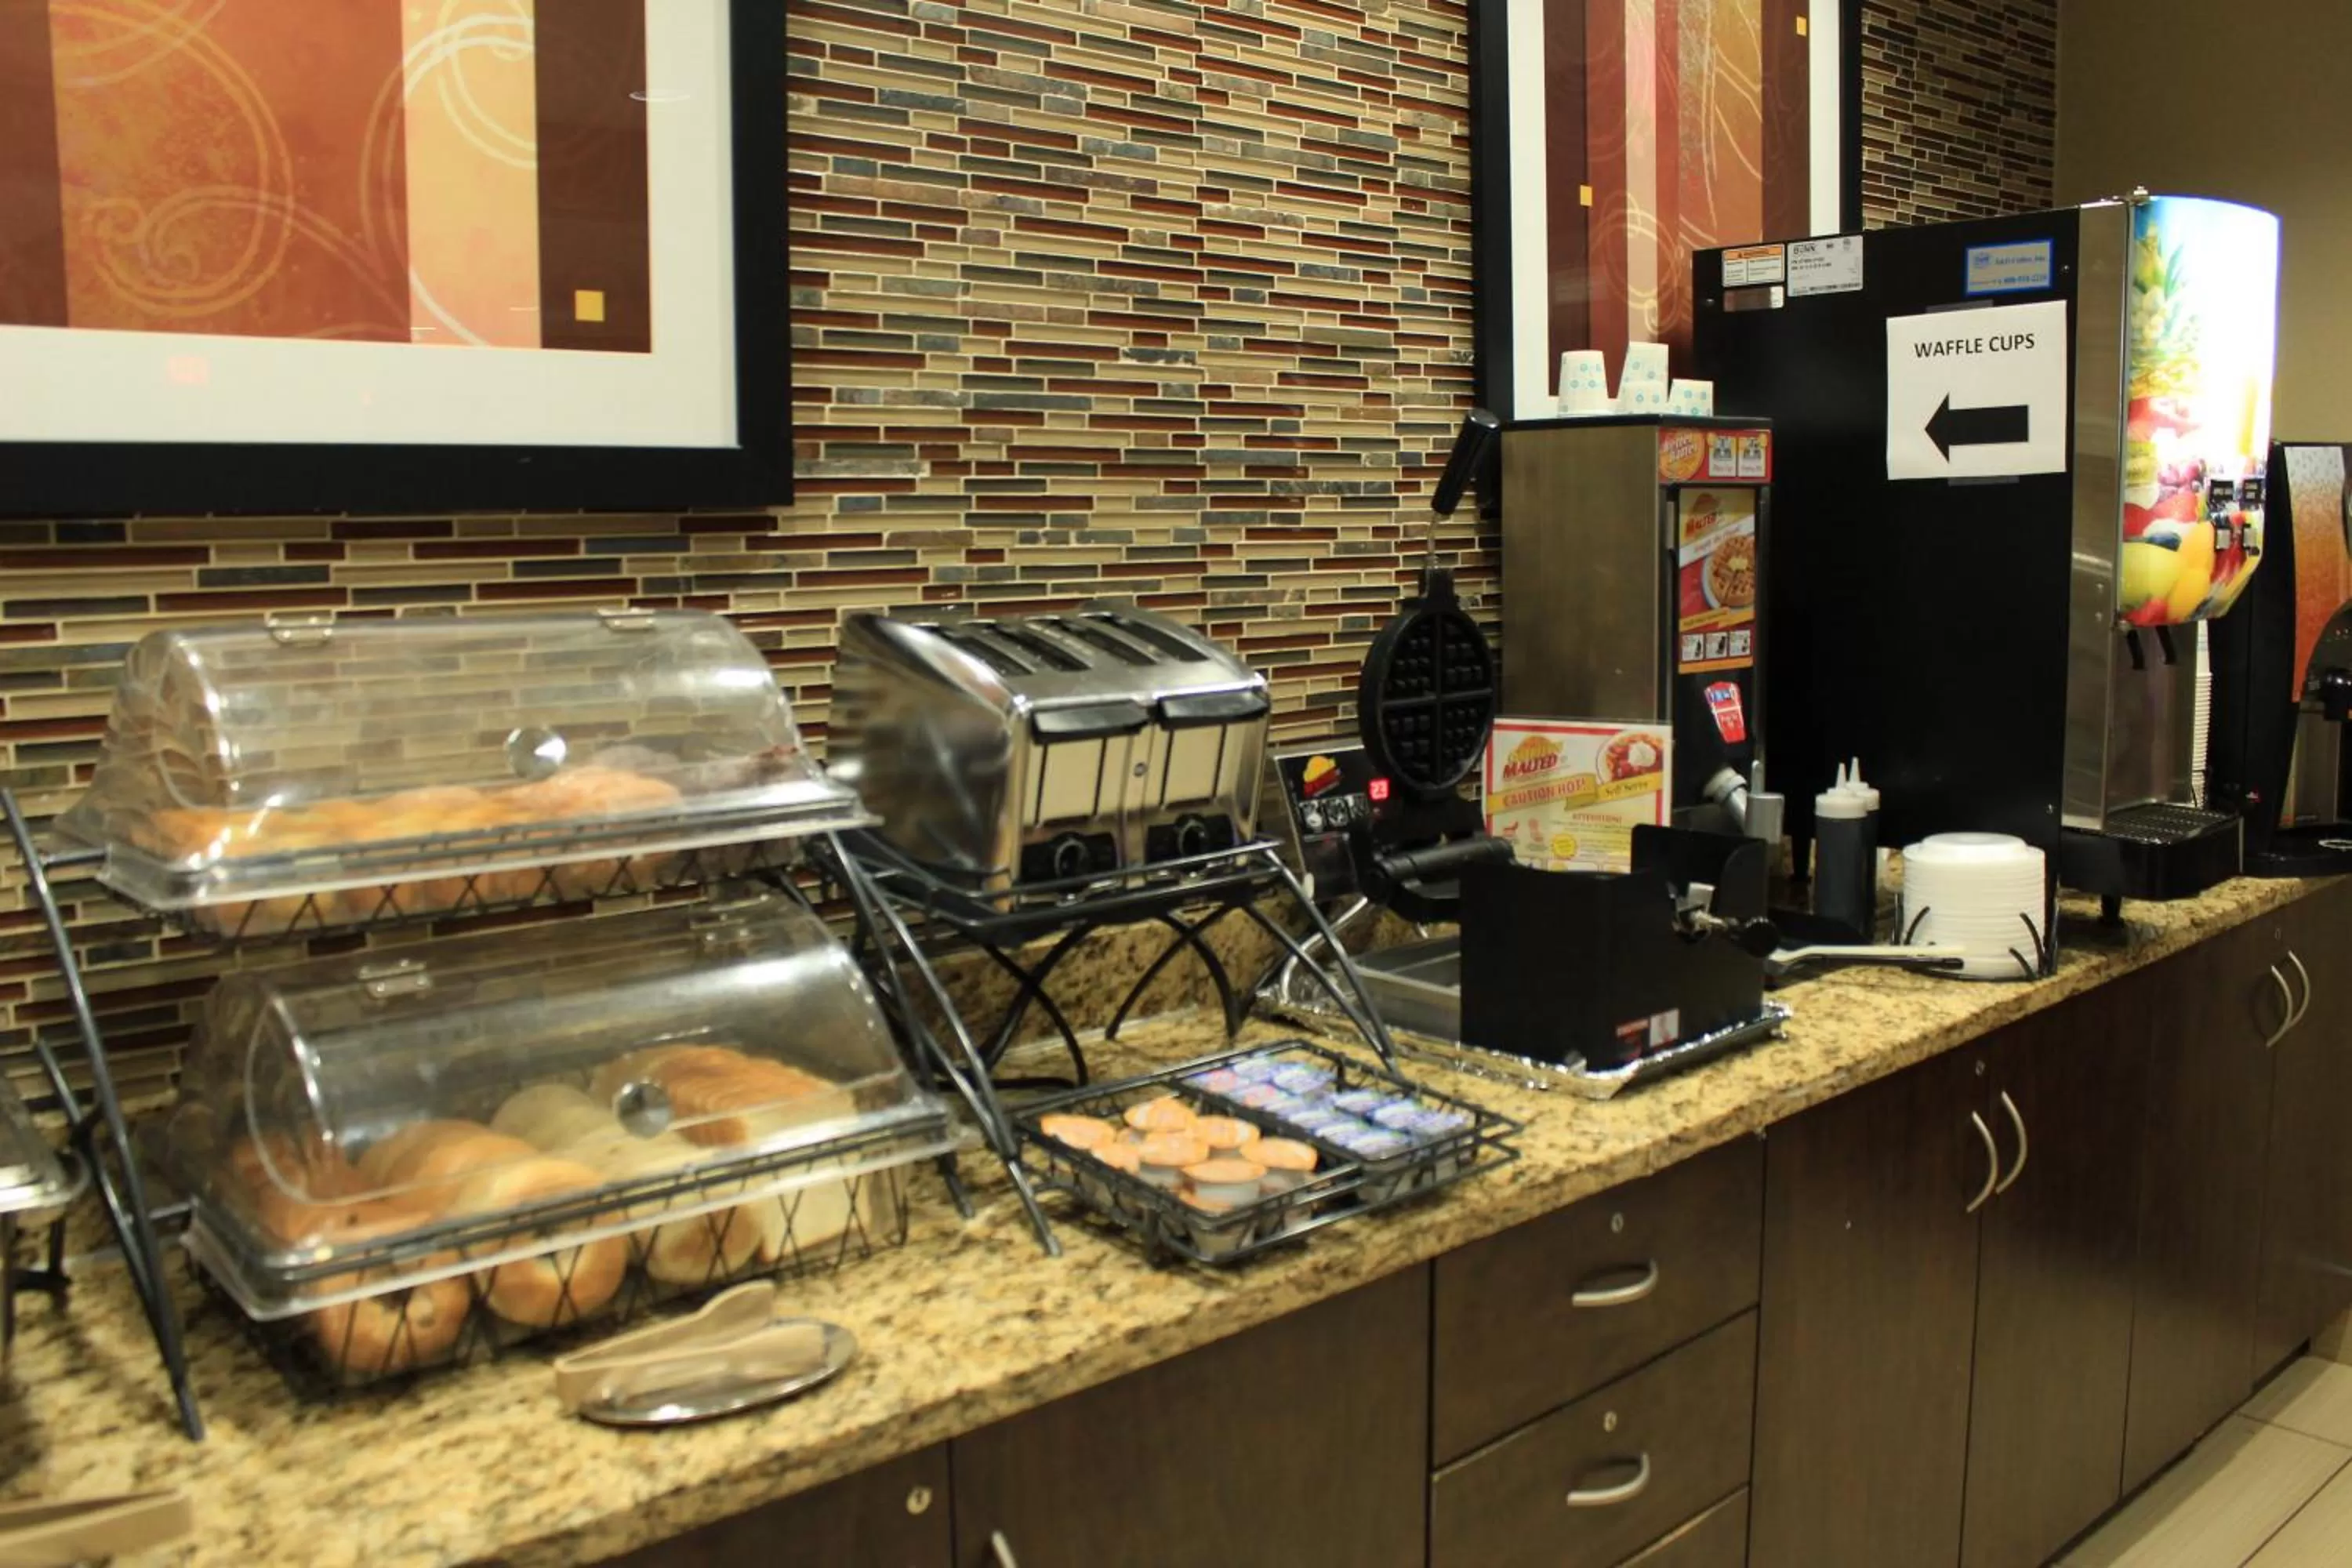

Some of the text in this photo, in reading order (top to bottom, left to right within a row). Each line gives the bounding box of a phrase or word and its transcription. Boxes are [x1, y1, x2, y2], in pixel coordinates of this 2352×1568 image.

[1914, 332, 2035, 358] WAFFLE CUPS
[1503, 752, 1559, 779] MALTED
[1503, 777, 1587, 808] CAUTION HOT!
